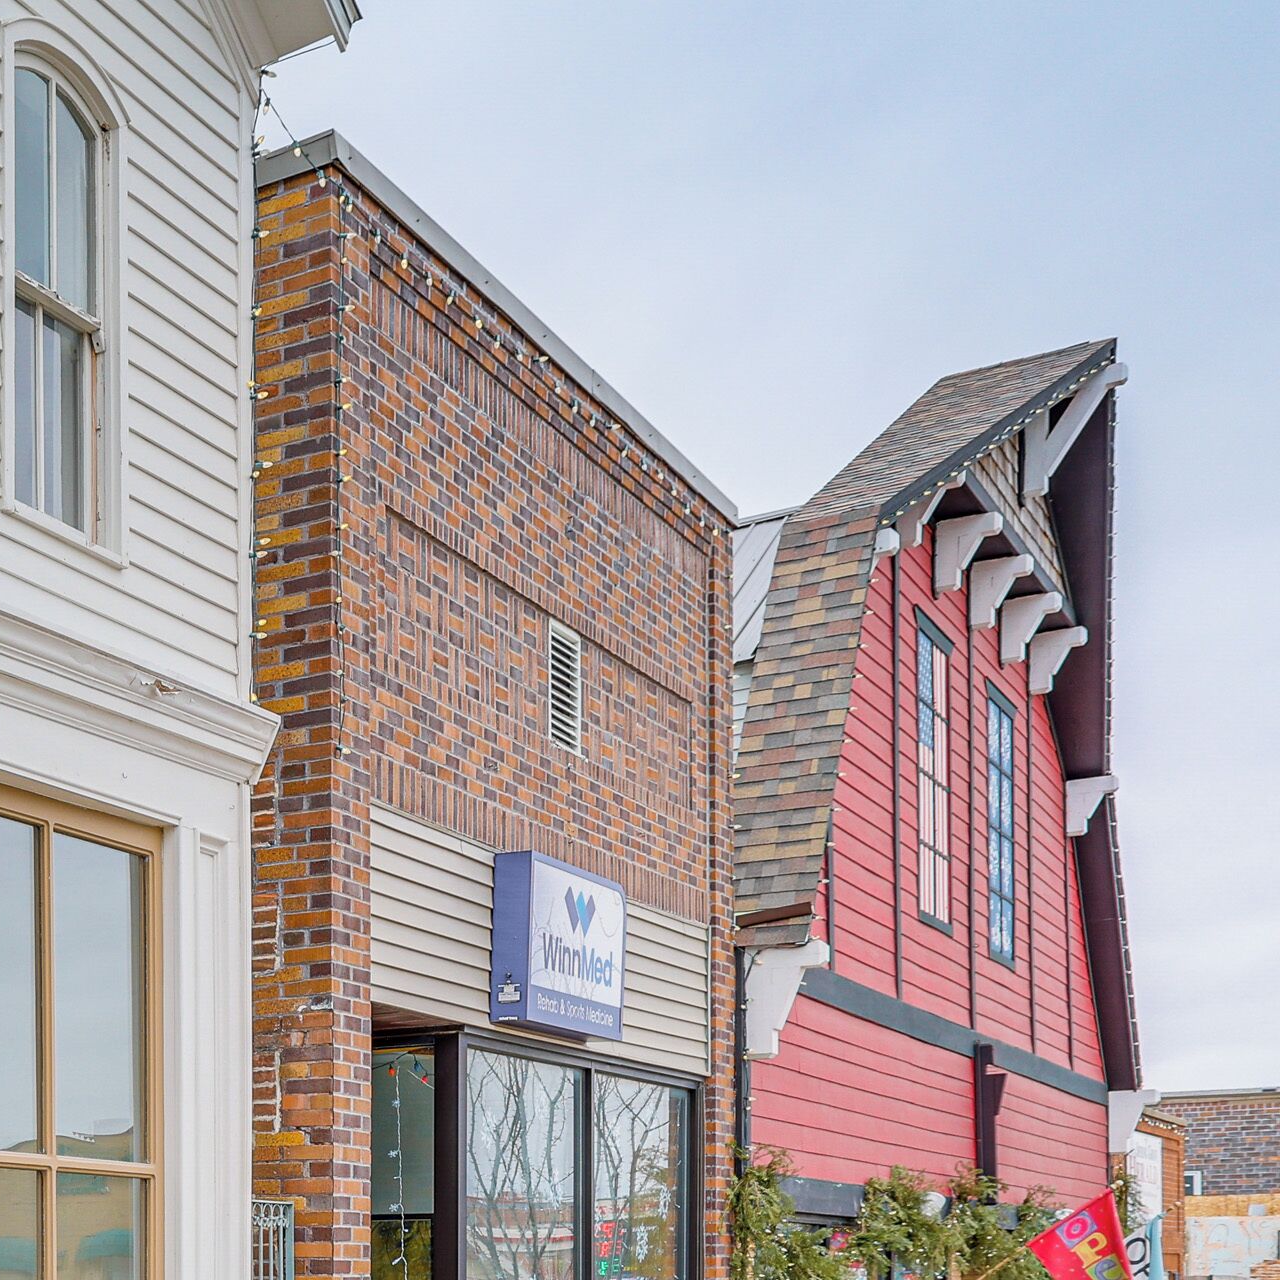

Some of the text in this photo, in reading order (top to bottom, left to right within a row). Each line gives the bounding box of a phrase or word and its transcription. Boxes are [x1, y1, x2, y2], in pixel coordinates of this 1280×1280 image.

[542, 932, 613, 988] WinnMed
[537, 992, 614, 1027] Rehab & Sports Medicine
